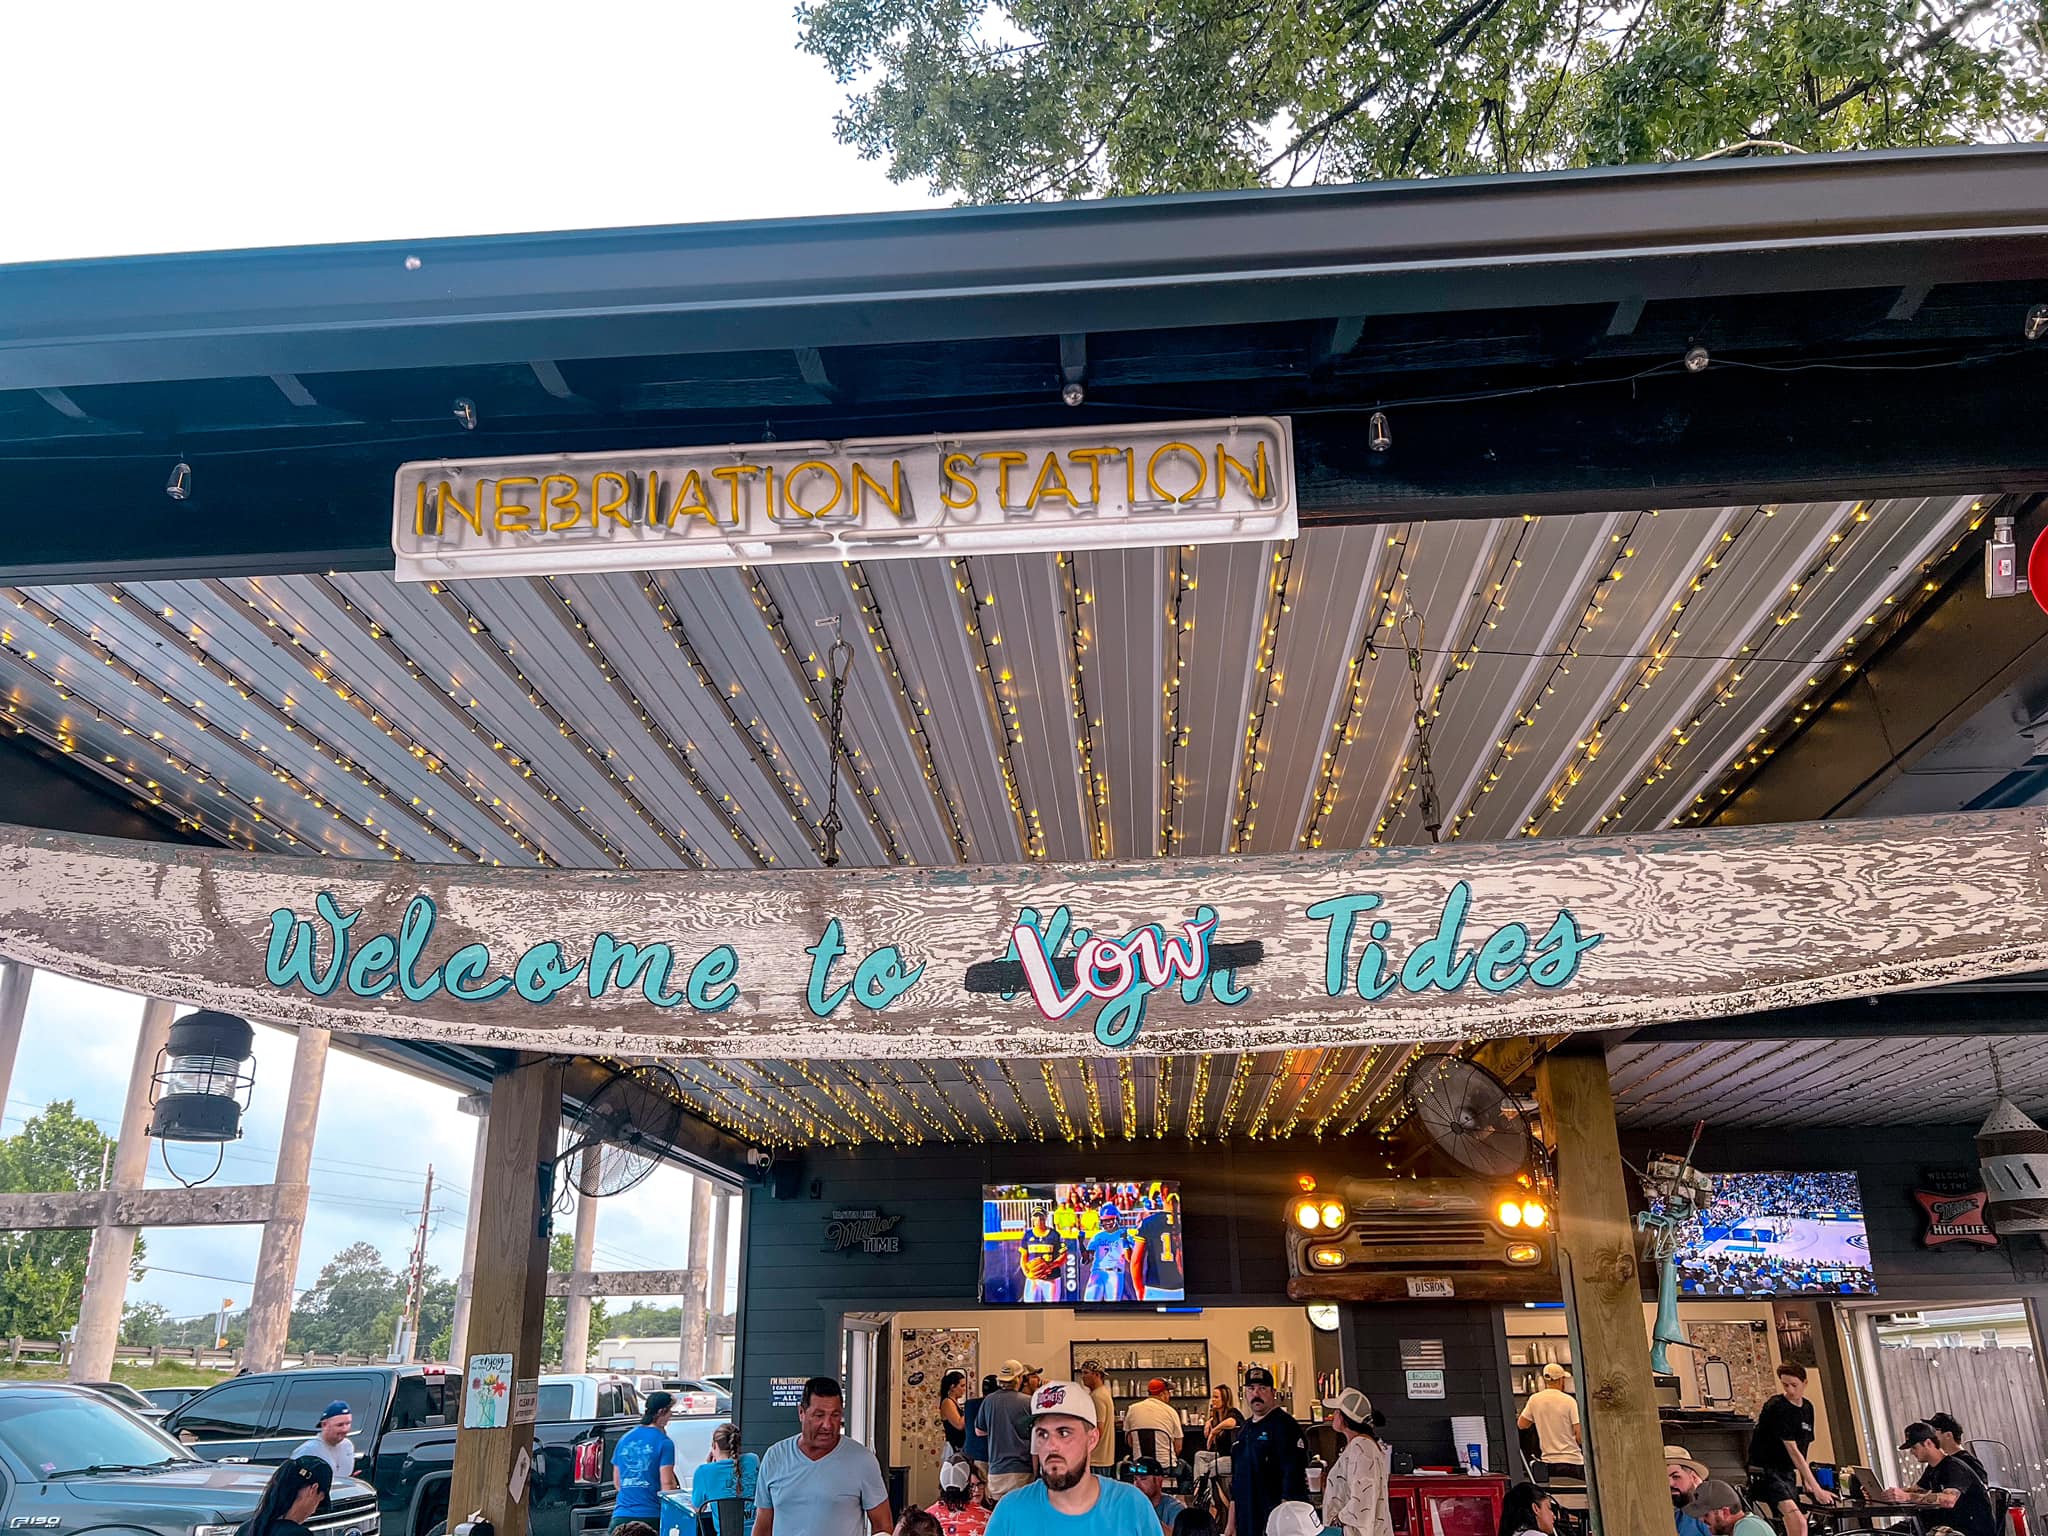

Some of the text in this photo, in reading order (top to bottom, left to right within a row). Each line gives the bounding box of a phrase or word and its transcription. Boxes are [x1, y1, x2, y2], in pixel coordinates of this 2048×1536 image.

[416, 441, 1266, 536] INEBRIATION STATION
[264, 879, 1604, 1021] Welcome to Low Tides
[824, 1214, 902, 1252] Miller
[862, 1237, 900, 1253] TIME
[1932, 1225, 1991, 1235] HIGH LIFE
